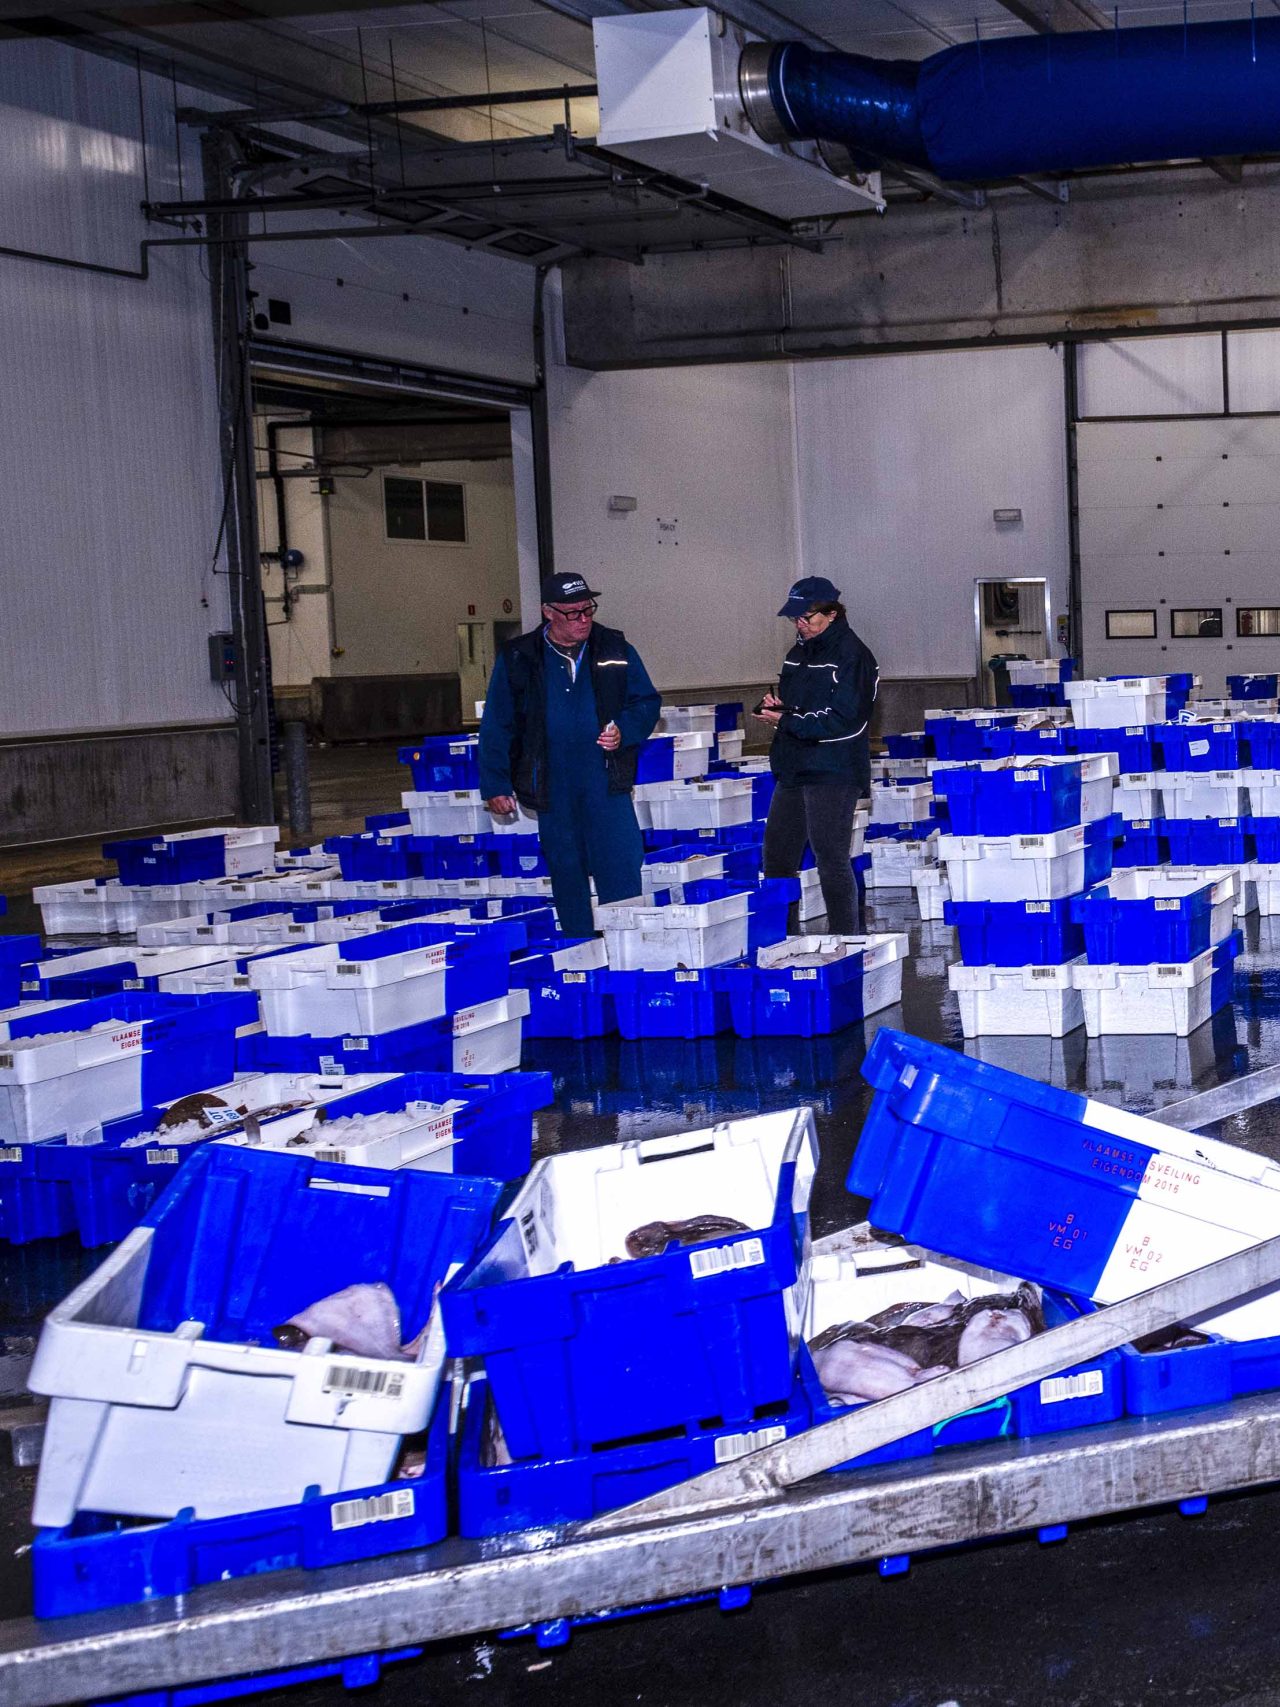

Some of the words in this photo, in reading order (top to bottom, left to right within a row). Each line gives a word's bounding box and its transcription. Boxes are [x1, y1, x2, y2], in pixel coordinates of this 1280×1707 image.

[111, 1029, 141, 1043] VLAAMSE
[427, 1117, 452, 1132] VLAAMSE
[1082, 1138, 1135, 1163] VLAAMSE
[1138, 1158, 1200, 1185] VSVEILING
[1091, 1157, 1152, 1185] EIGENDOM
[1154, 1178, 1180, 1194] 2016
[1065, 1213, 1075, 1225] B
[1048, 1221, 1067, 1235] VM
[1072, 1229, 1088, 1241] 01
[1052, 1236, 1073, 1250] EG
[1141, 1236, 1151, 1247] B
[1125, 1243, 1143, 1257] VM
[1147, 1250, 1163, 1263] 02
[1129, 1258, 1149, 1272] EG
